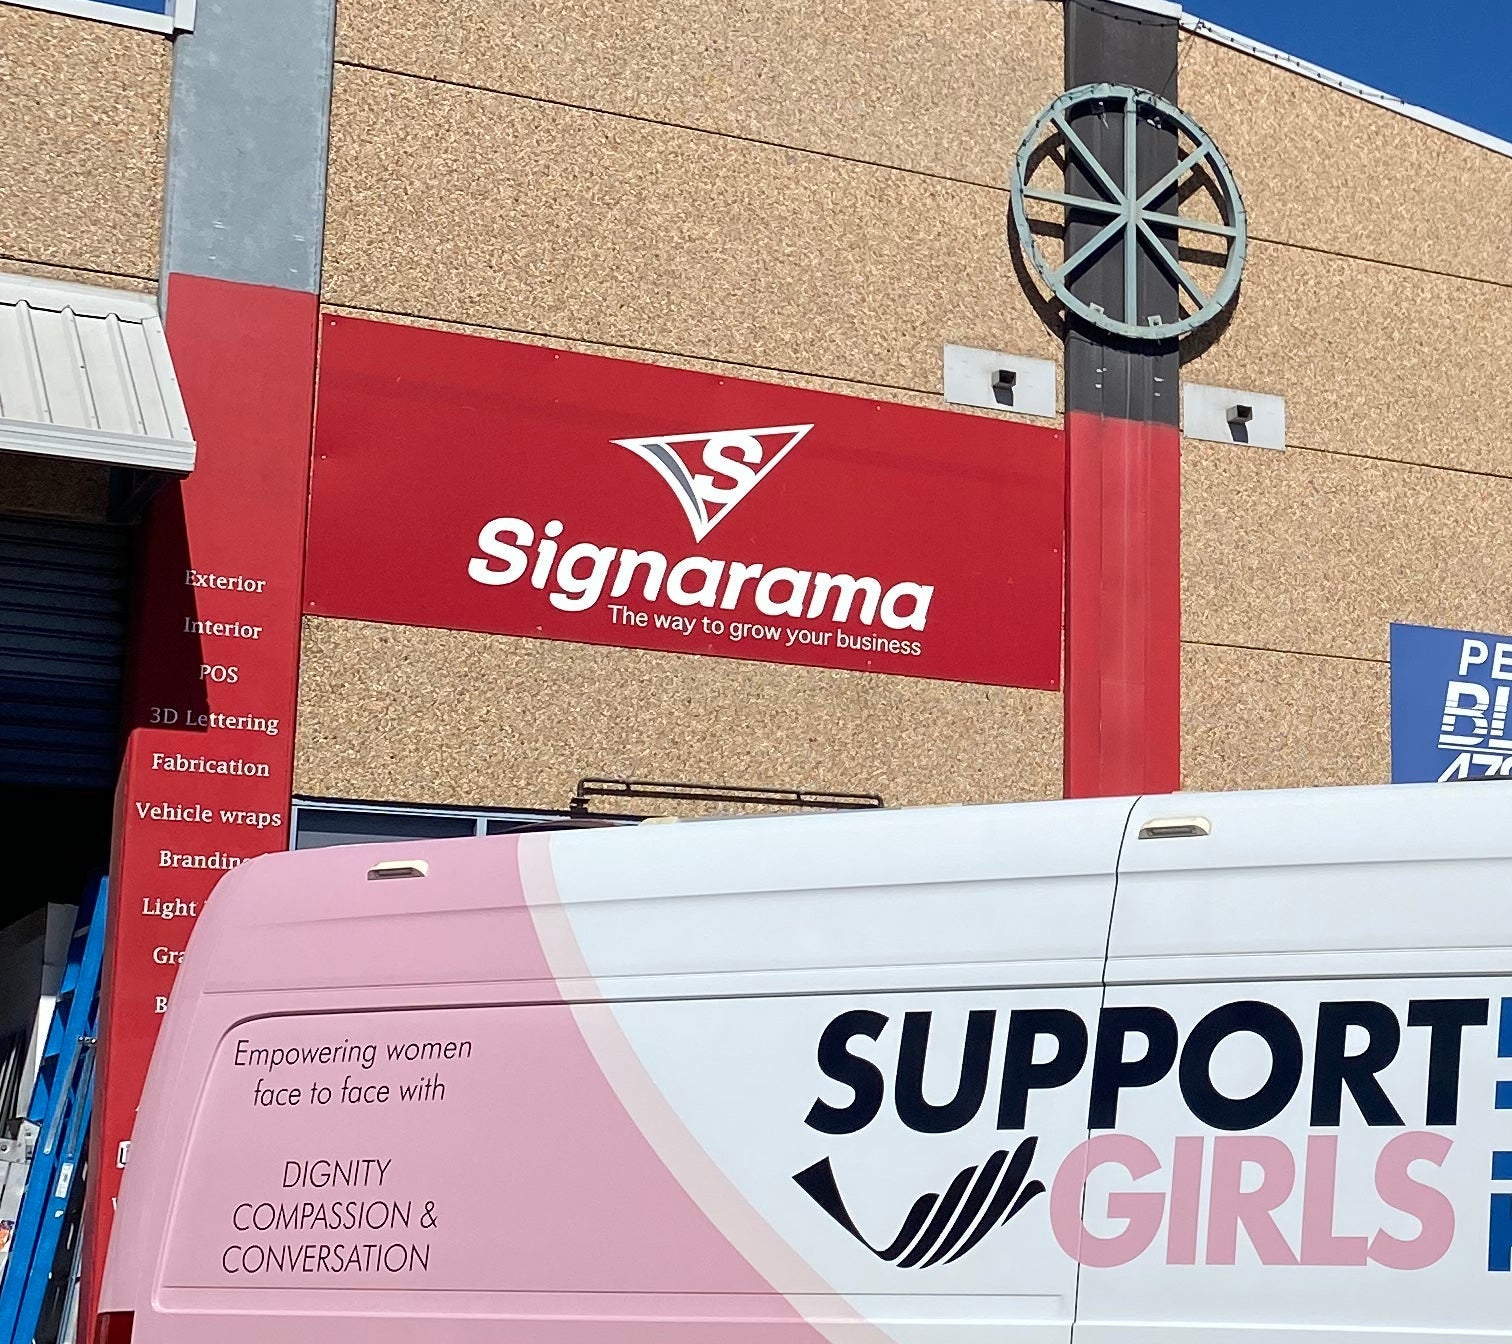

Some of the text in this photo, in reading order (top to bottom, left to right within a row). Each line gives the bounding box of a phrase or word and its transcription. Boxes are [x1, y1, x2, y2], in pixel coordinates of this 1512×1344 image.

[185, 569, 266, 593] Exterior
[467, 516, 935, 632] Signarama
[184, 617, 263, 639] Interior
[608, 604, 922, 656] The way to grow your business
[199, 664, 239, 683] POS
[150, 707, 279, 736] 3D Lettering
[152, 753, 270, 777] Fabrication
[136, 801, 282, 828] Vehicle wraps
[142, 897, 198, 919] Light
[234, 1039, 472, 1072] Empowering women
[803, 999, 1490, 1135] SUPPORT
[254, 1073, 446, 1106] face to face with
[282, 1158, 392, 1187] DIGNITY
[232, 1200, 438, 1230] COMPASSION &
[1049, 1130, 1456, 1271] GIRLS
[222, 1243, 430, 1273] CONVERSATION
